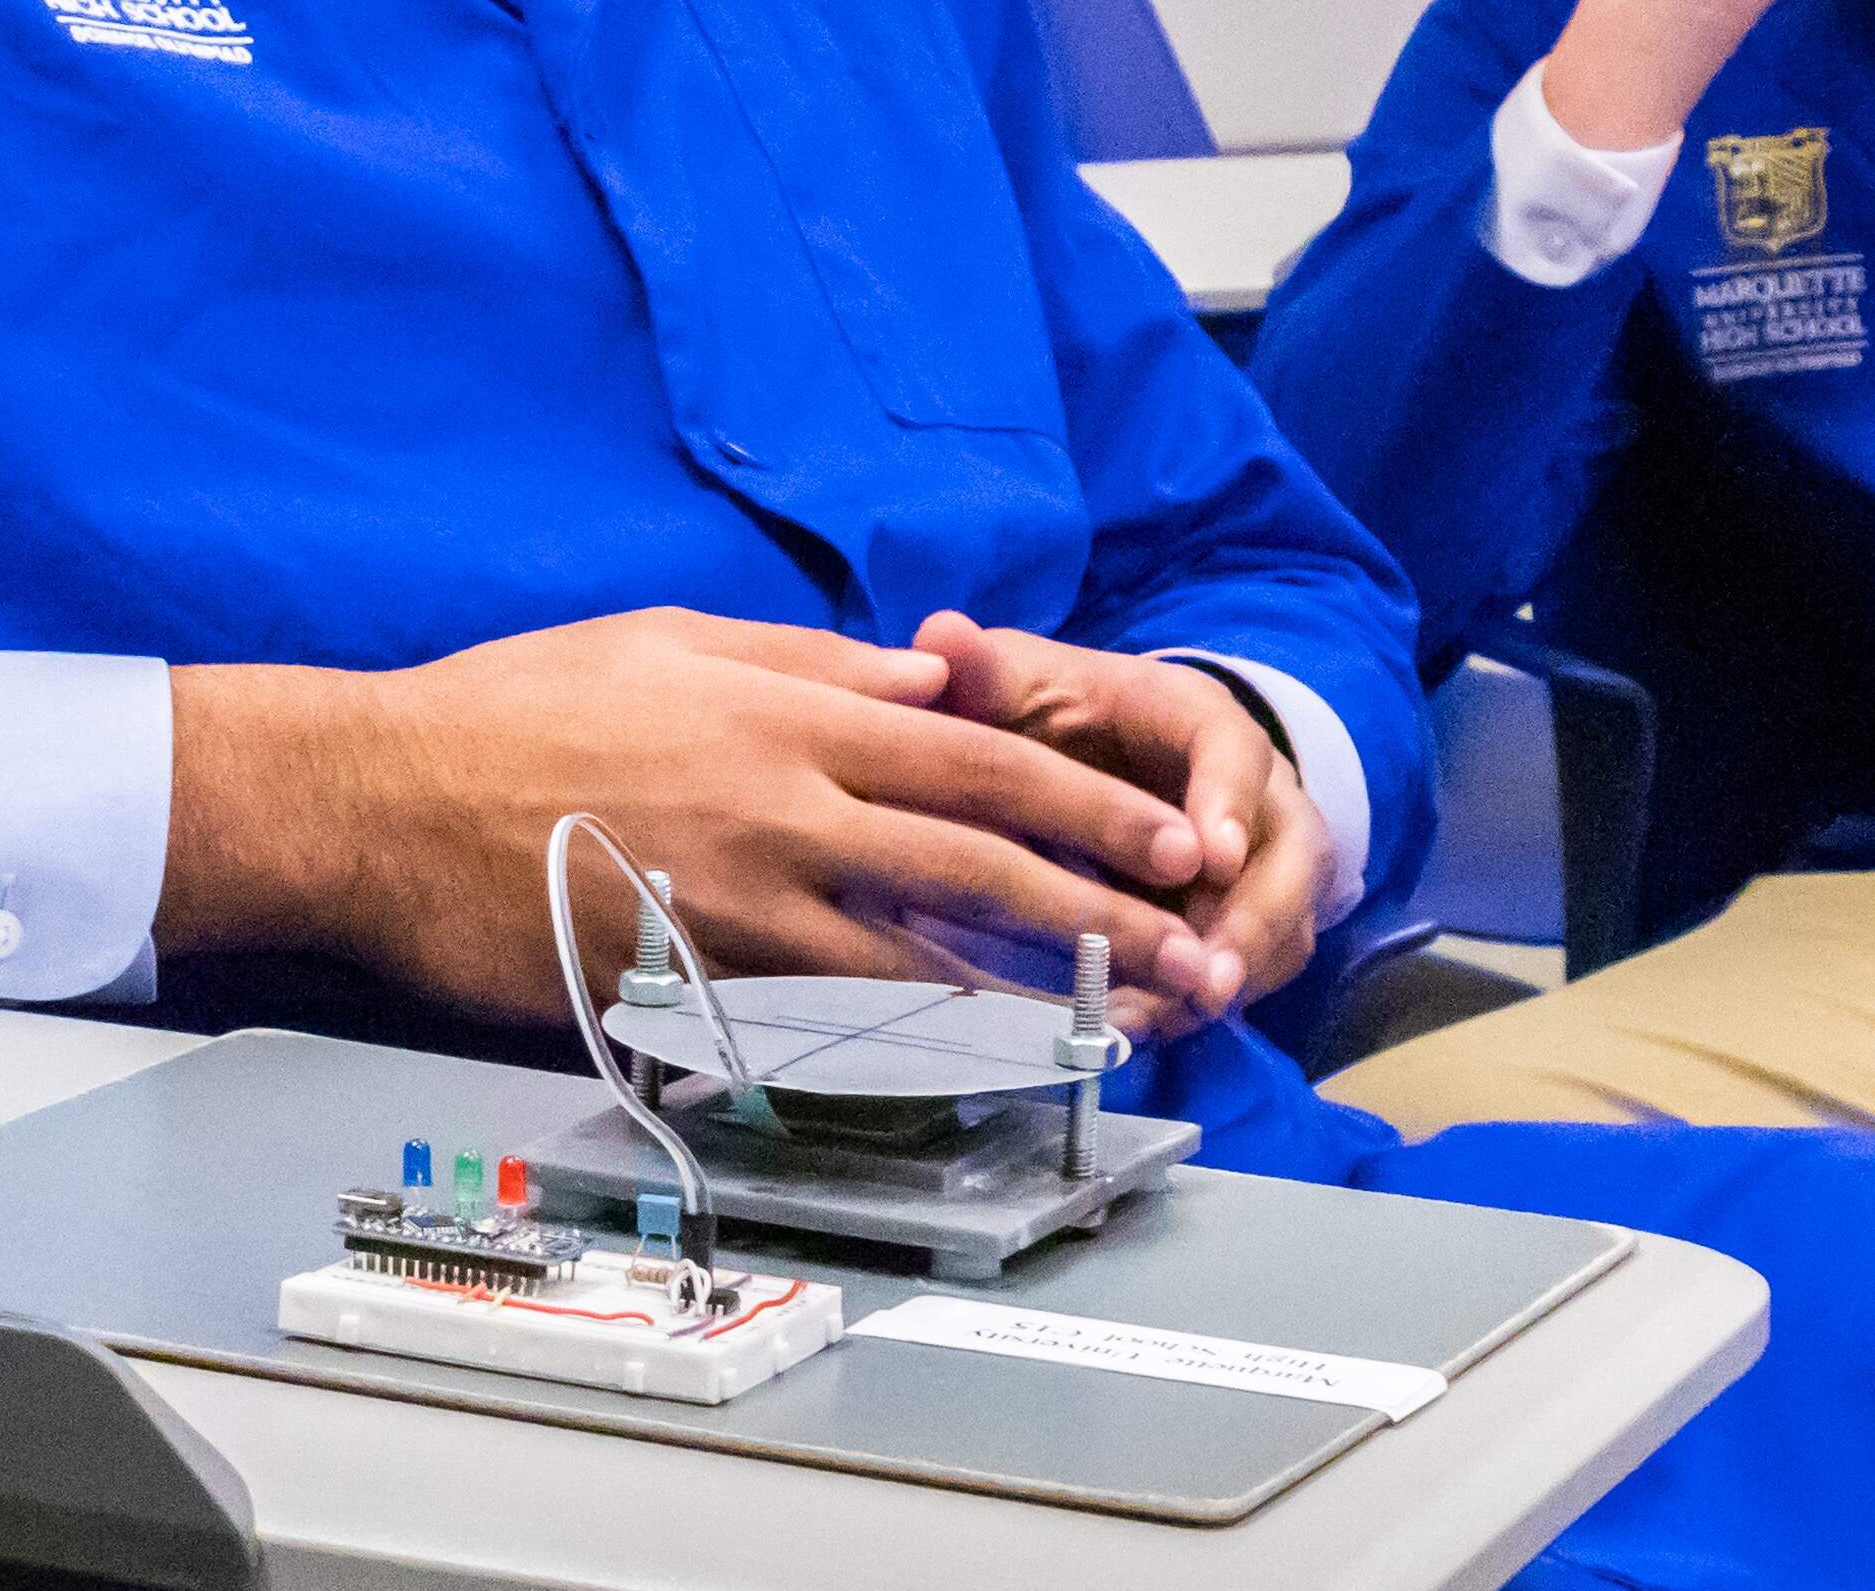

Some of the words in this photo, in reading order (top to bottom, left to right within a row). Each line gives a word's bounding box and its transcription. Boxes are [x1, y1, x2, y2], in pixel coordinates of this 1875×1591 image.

[120, 5, 247, 31] SCHOOL
[1694, 266, 1867, 306] MARQUETTE
[969, 1329, 1141, 1360] University
[1099, 1333, 1217, 1357] School
[1164, 1357, 1340, 1388] Marquette
[1242, 1351, 1328, 1371] High
